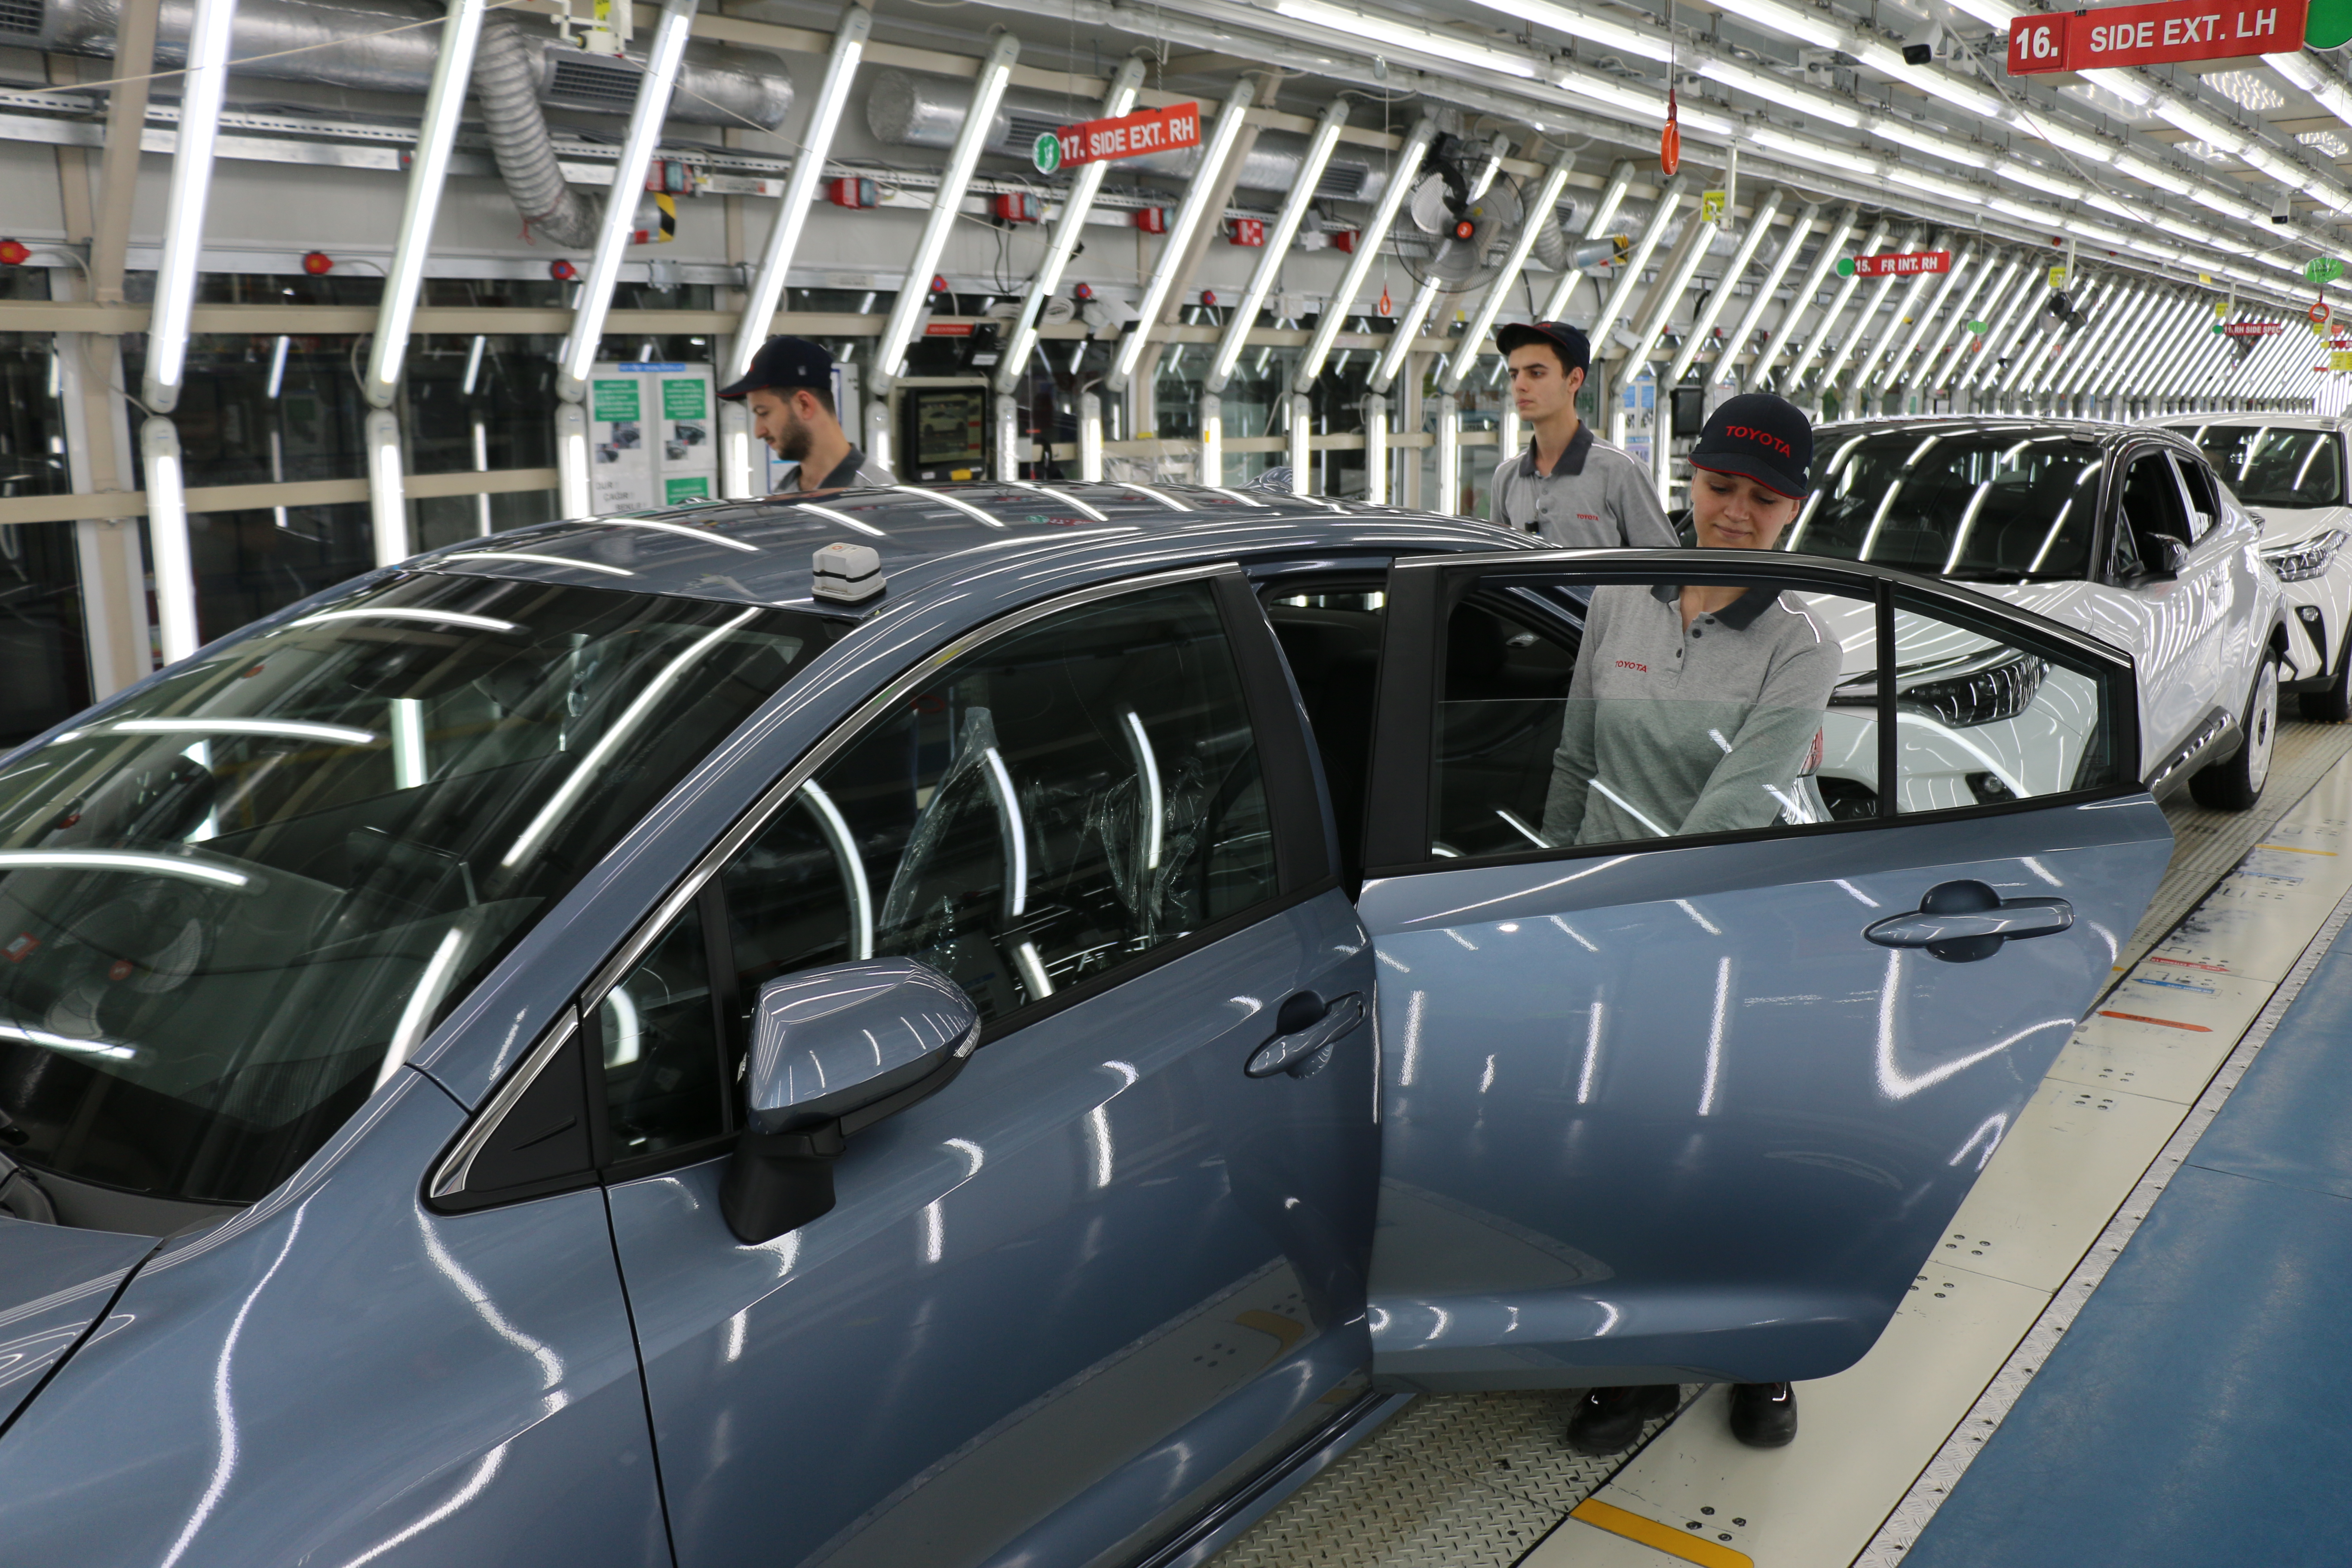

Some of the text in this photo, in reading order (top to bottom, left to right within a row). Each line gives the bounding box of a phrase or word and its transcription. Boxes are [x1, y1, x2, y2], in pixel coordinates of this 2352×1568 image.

[2016, 8, 2277, 60] 16. SIDE EXT. LH
[1061, 116, 1194, 160] 17. SIDE EXT. RH
[1855, 256, 1938, 273] 15. FR INT. RH
[2263, 325, 2281, 334] SPEC
[1726, 426, 1790, 458] TOYOTA
[1577, 513, 1599, 521] TOYOTA
[1615, 660, 1647, 673] TOYOTA
